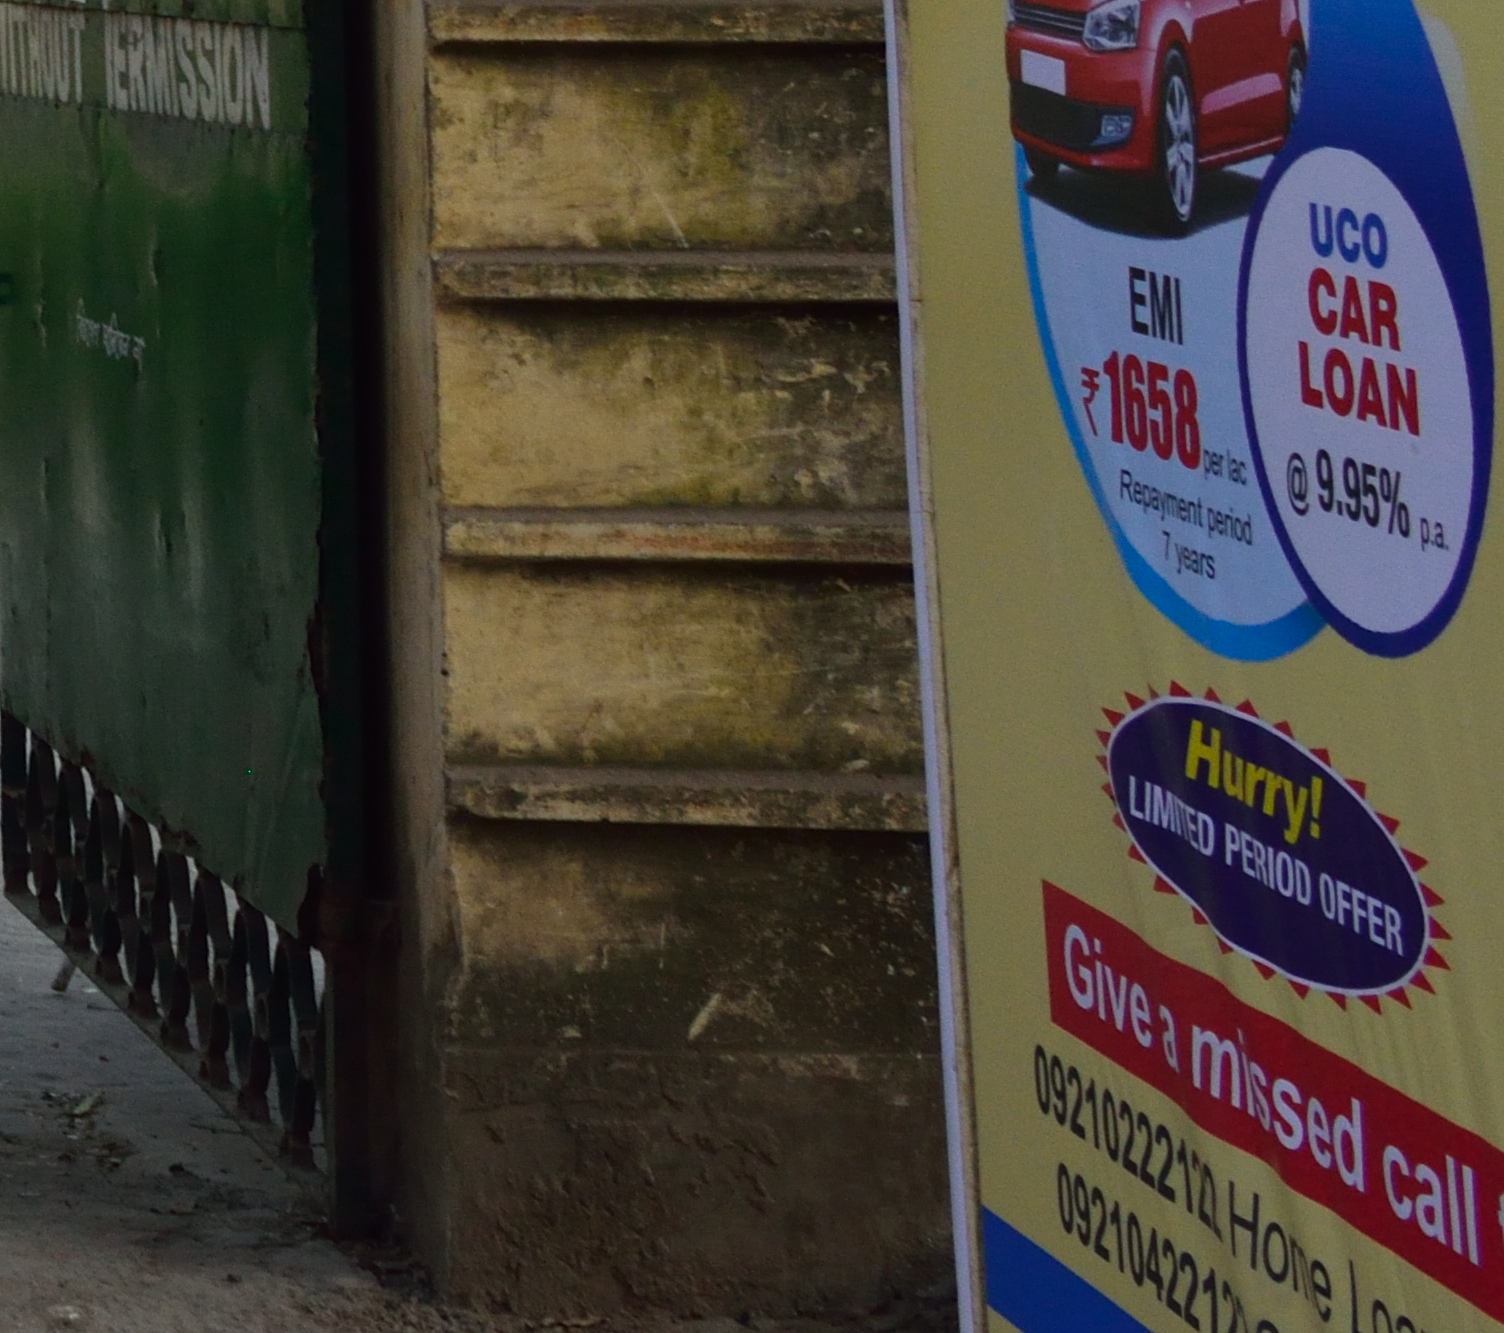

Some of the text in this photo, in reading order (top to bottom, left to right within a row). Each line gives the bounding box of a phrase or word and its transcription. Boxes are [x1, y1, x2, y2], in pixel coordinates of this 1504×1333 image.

[1308, 202, 1388, 269] UCO
[1128, 265, 1184, 346] EMI
[1308, 267, 1401, 352] CAR
[1081, 350, 1248, 486] ₹1658 per lac
[1298, 340, 1420, 437] LOAN
[1120, 468, 1253, 547] Repayment period
[1287, 448, 1450, 552] @ 9.95% p.a.
[1162, 530, 1216, 580] 7 years
[1184, 718, 1324, 845] Hurry!
[1129, 774, 1405, 957] LIMITED PERIOD OFFER
[1062, 923, 1153, 1050] Give
[1159, 1000, 1180, 1075] a
[1191, 1022, 1366, 1194] missed
[1382, 1142, 1482, 1267] call
